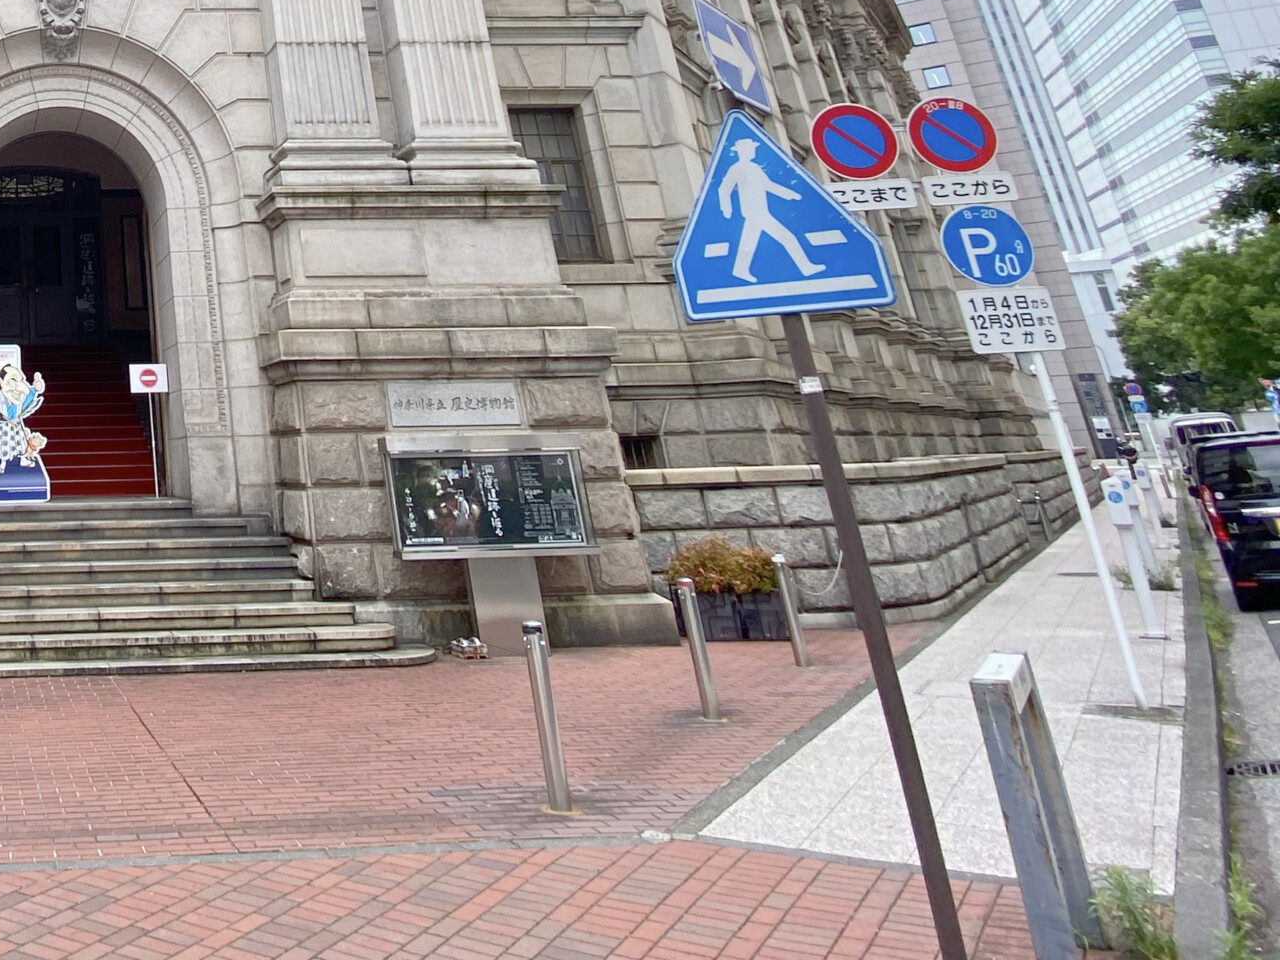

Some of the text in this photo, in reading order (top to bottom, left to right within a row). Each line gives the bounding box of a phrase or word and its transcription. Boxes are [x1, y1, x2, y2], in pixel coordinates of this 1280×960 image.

[832, 186, 908, 205] ここまで
[931, 179, 1011, 198] ここから
[963, 209, 998, 220] 8-20
[959, 228, 997, 278] P
[995, 254, 1021, 277] 60
[968, 295, 1049, 313] 1月4日から
[970, 313, 1055, 330] 12月31日まで
[978, 330, 1057, 346] ここから
